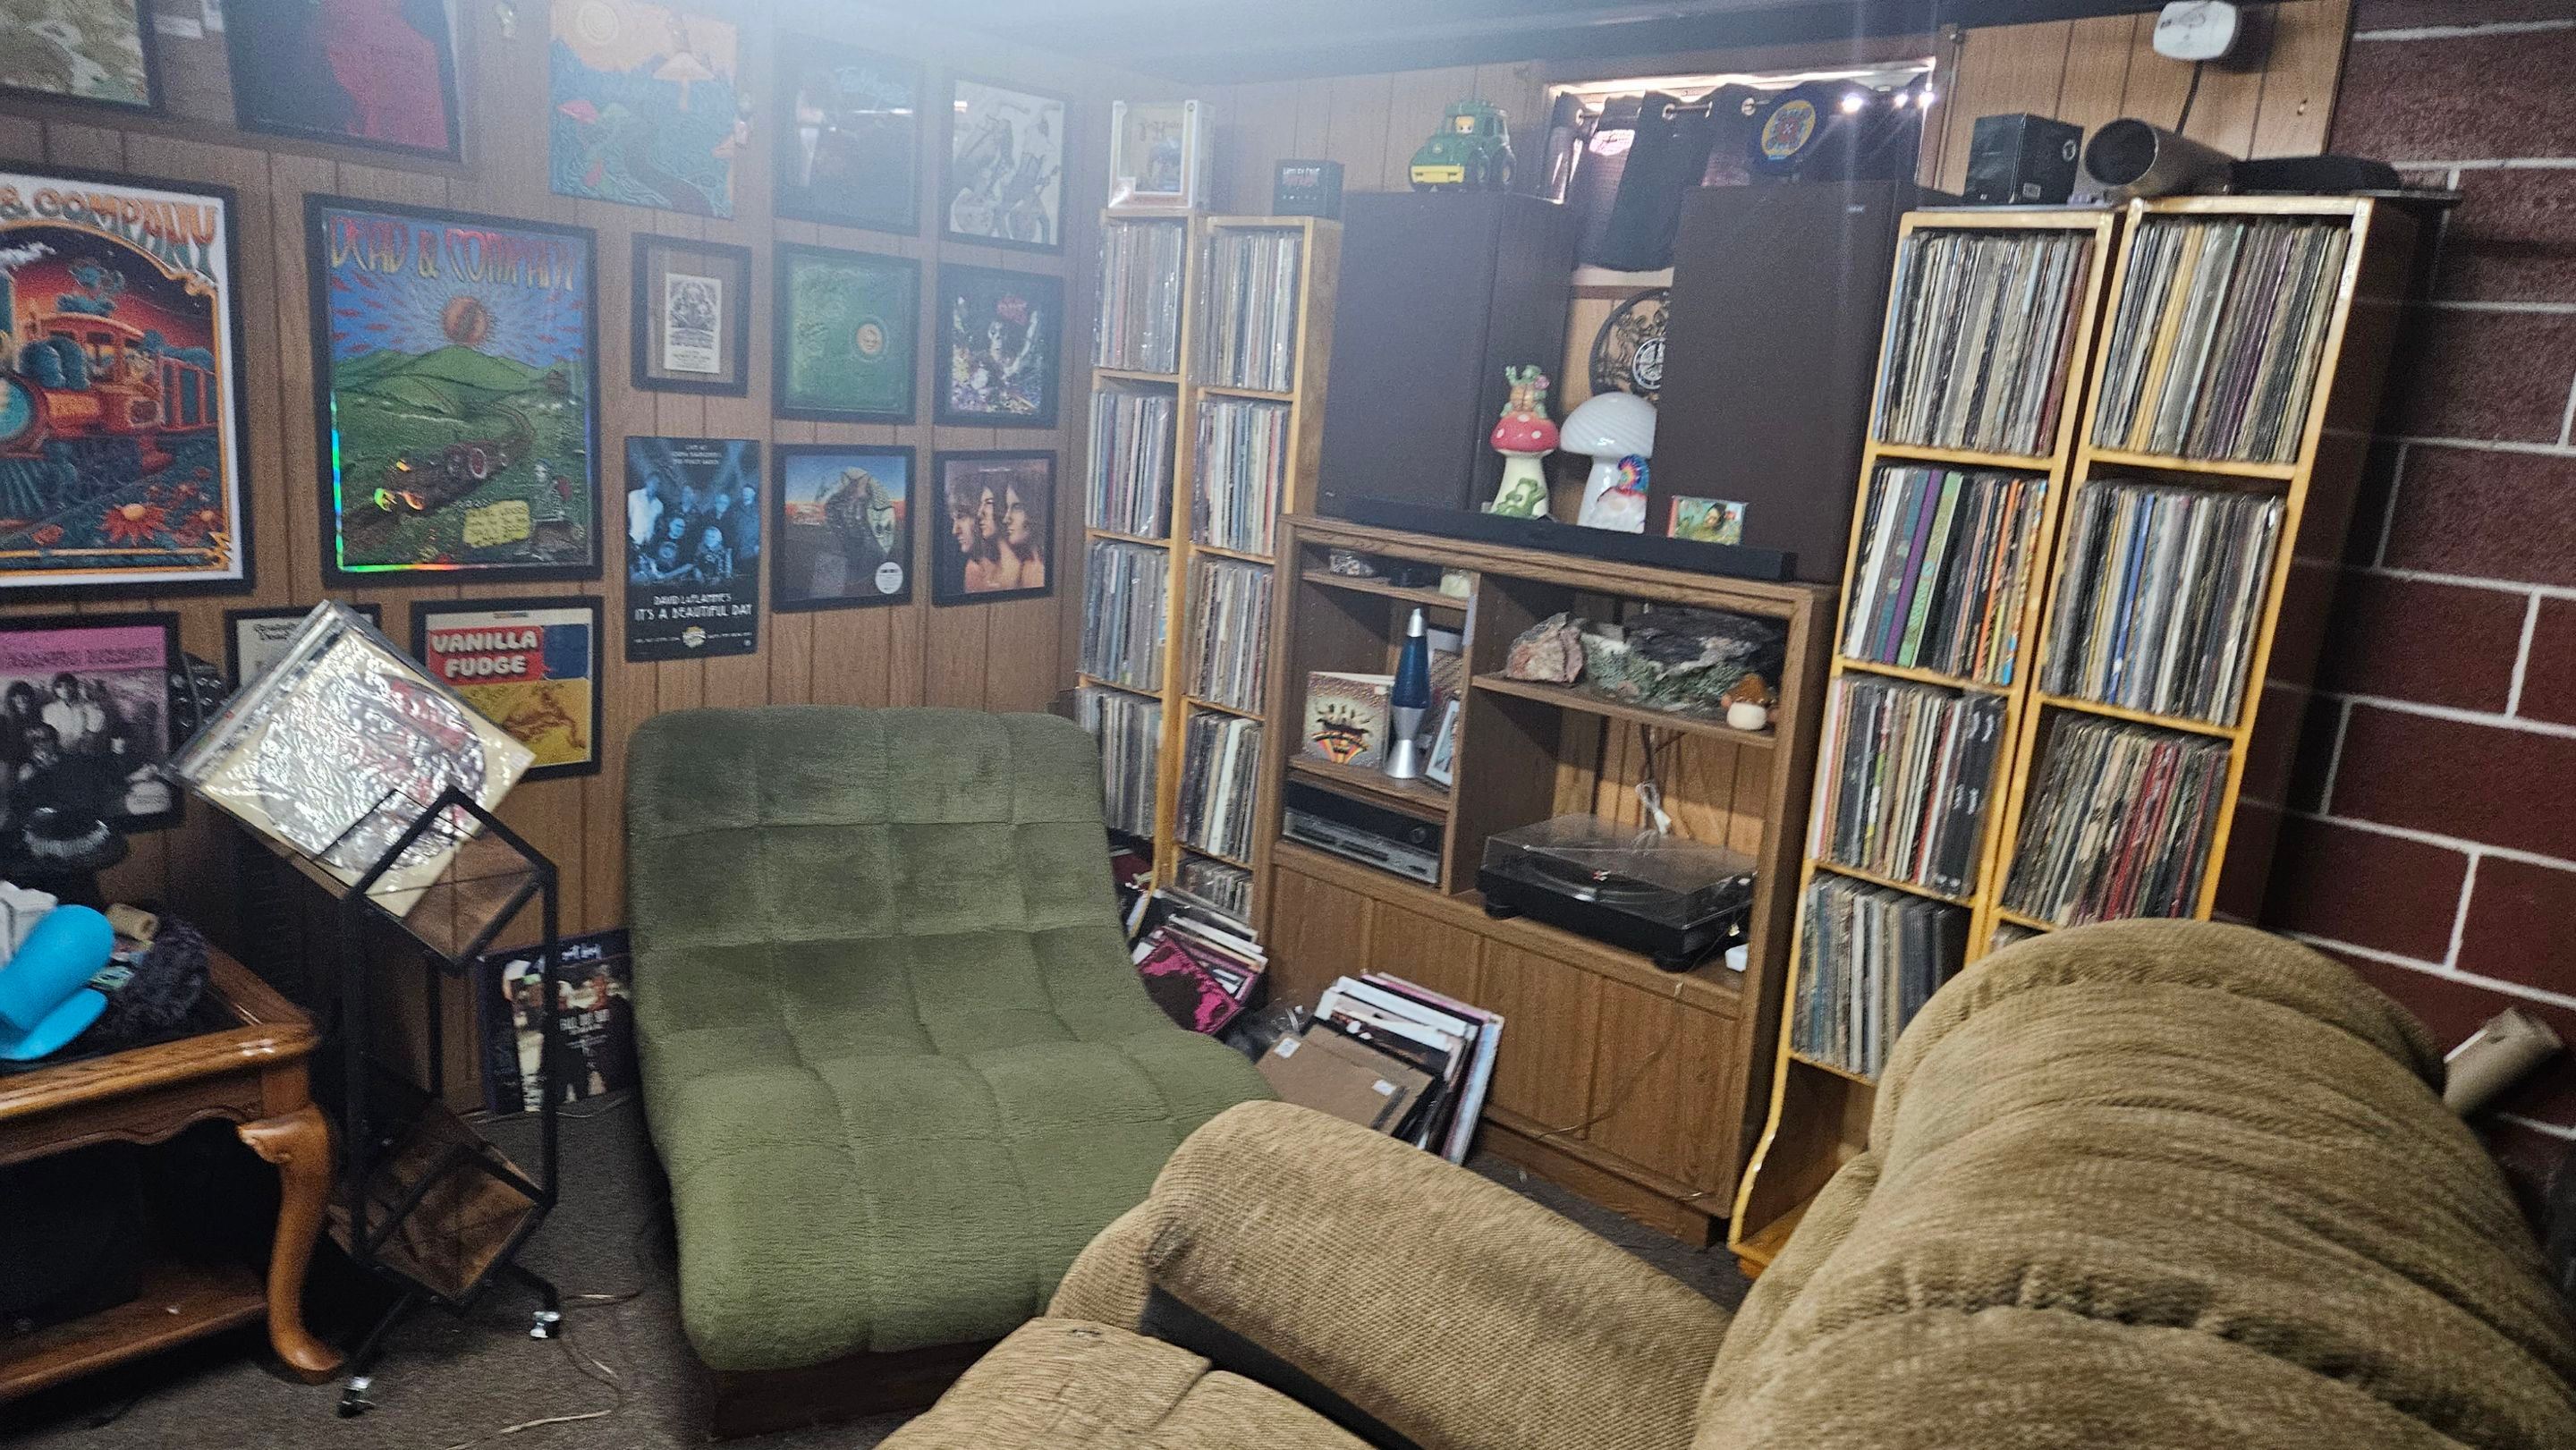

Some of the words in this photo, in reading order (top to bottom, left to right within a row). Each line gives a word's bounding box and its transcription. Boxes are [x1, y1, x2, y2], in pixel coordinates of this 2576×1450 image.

[330, 216, 408, 276] DEAD
[418, 229, 440, 278] &
[445, 227, 575, 292] COMPANY
[634, 608, 655, 622] IT'S
[657, 607, 669, 620] A
[672, 605, 729, 619] BEAUTIFUL
[731, 603, 753, 615] DAY
[431, 630, 538, 653] VANILLA
[445, 655, 527, 678] FUDGE
